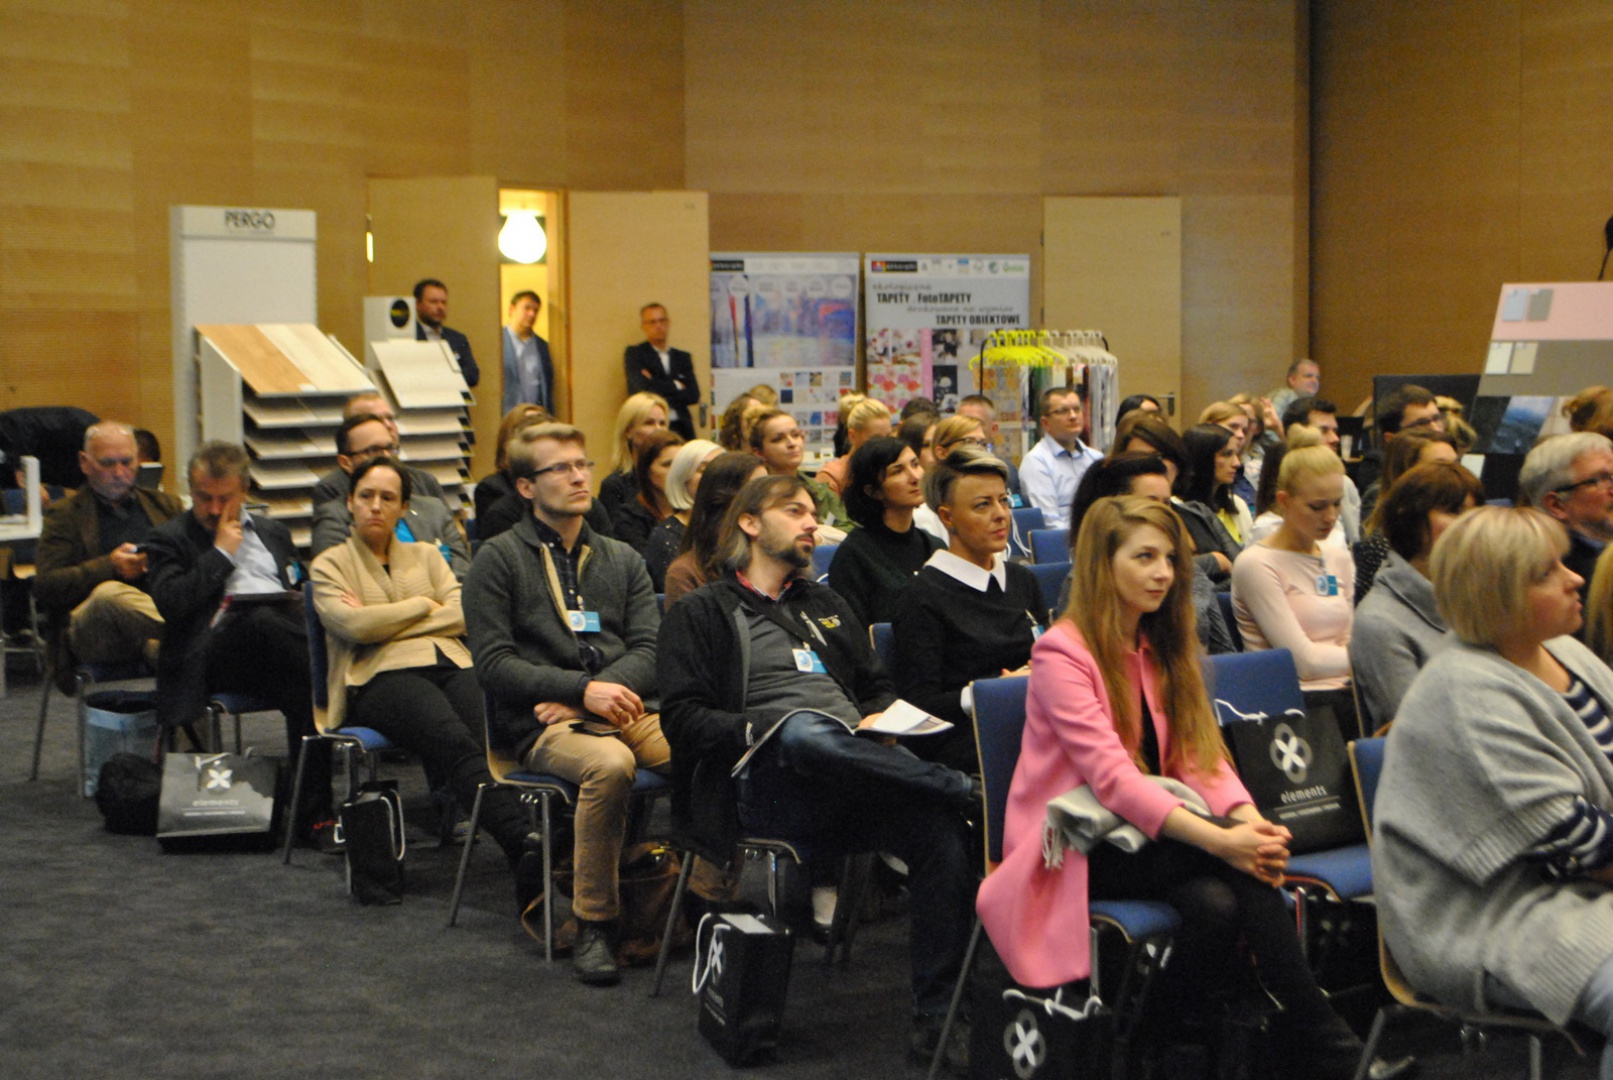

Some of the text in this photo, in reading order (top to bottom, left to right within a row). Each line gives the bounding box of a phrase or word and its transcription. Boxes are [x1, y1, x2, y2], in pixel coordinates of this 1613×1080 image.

[225, 210, 276, 229] PERGO
[877, 292, 910, 304] TAPETY
[936, 314, 1020, 325] TAPETY OBIEKTOWE
[1280, 784, 1328, 804] elements
